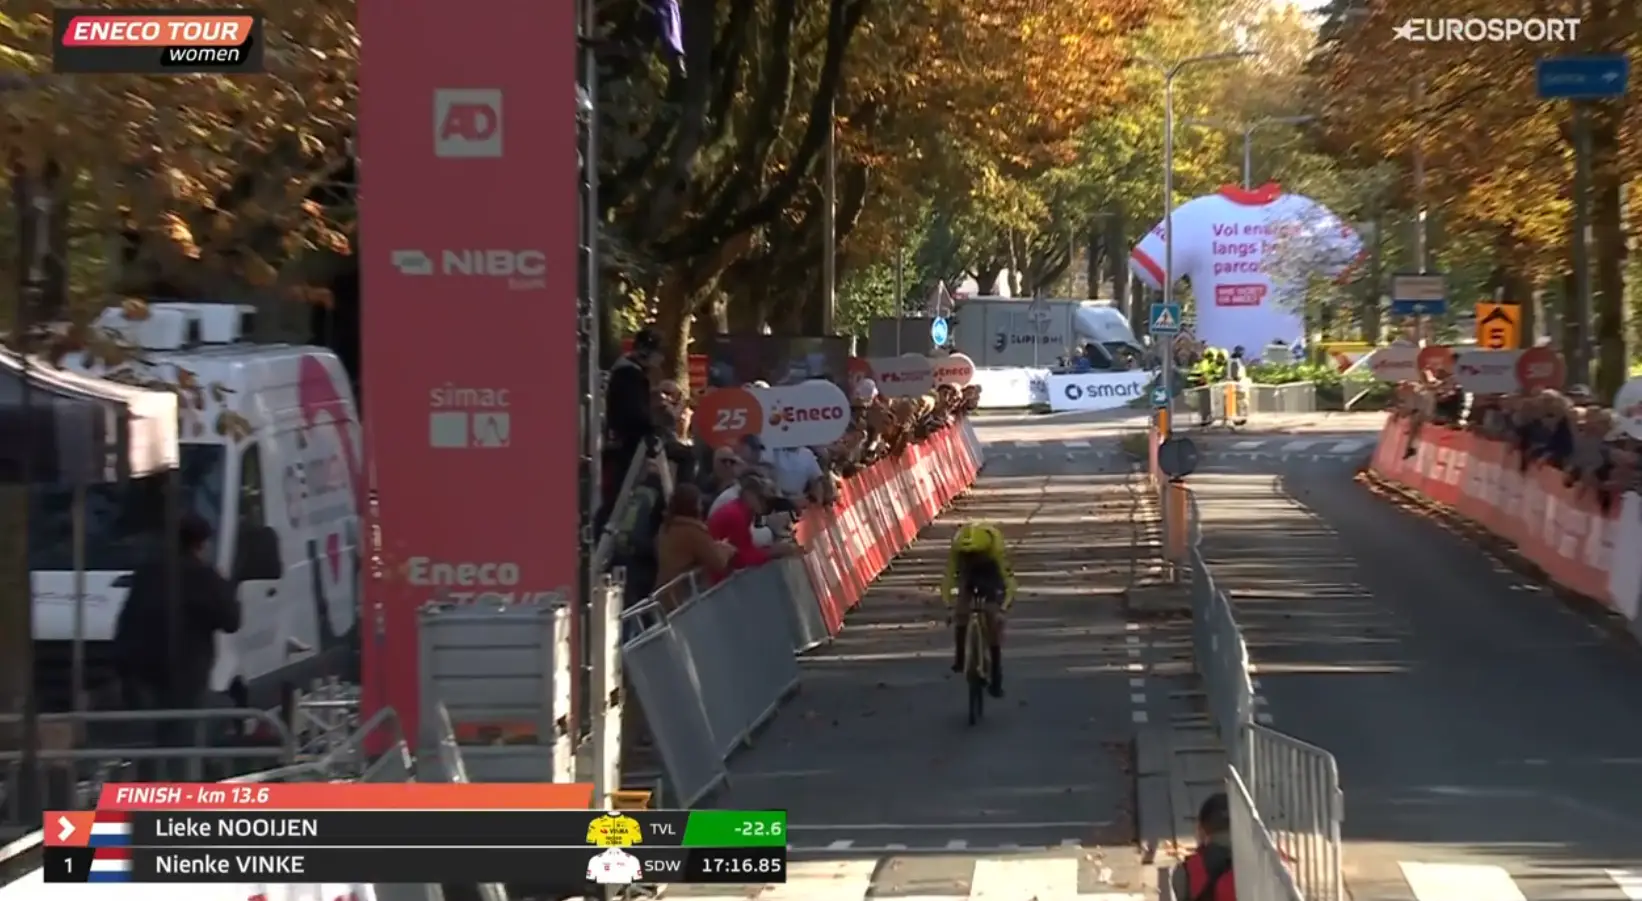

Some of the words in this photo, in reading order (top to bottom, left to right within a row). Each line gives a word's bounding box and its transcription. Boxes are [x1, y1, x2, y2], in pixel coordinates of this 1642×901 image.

[439, 103, 498, 142] AD
[1212, 223, 1238, 236] Vol
[1212, 241, 1258, 257] langs
[442, 249, 546, 276] NIBC
[938, 366, 971, 377] Eneco
[430, 381, 510, 407] simac
[1086, 382, 1140, 397] smart
[713, 408, 748, 431] 25
[783, 405, 843, 422] Eneco
[408, 556, 519, 586] Eneco
